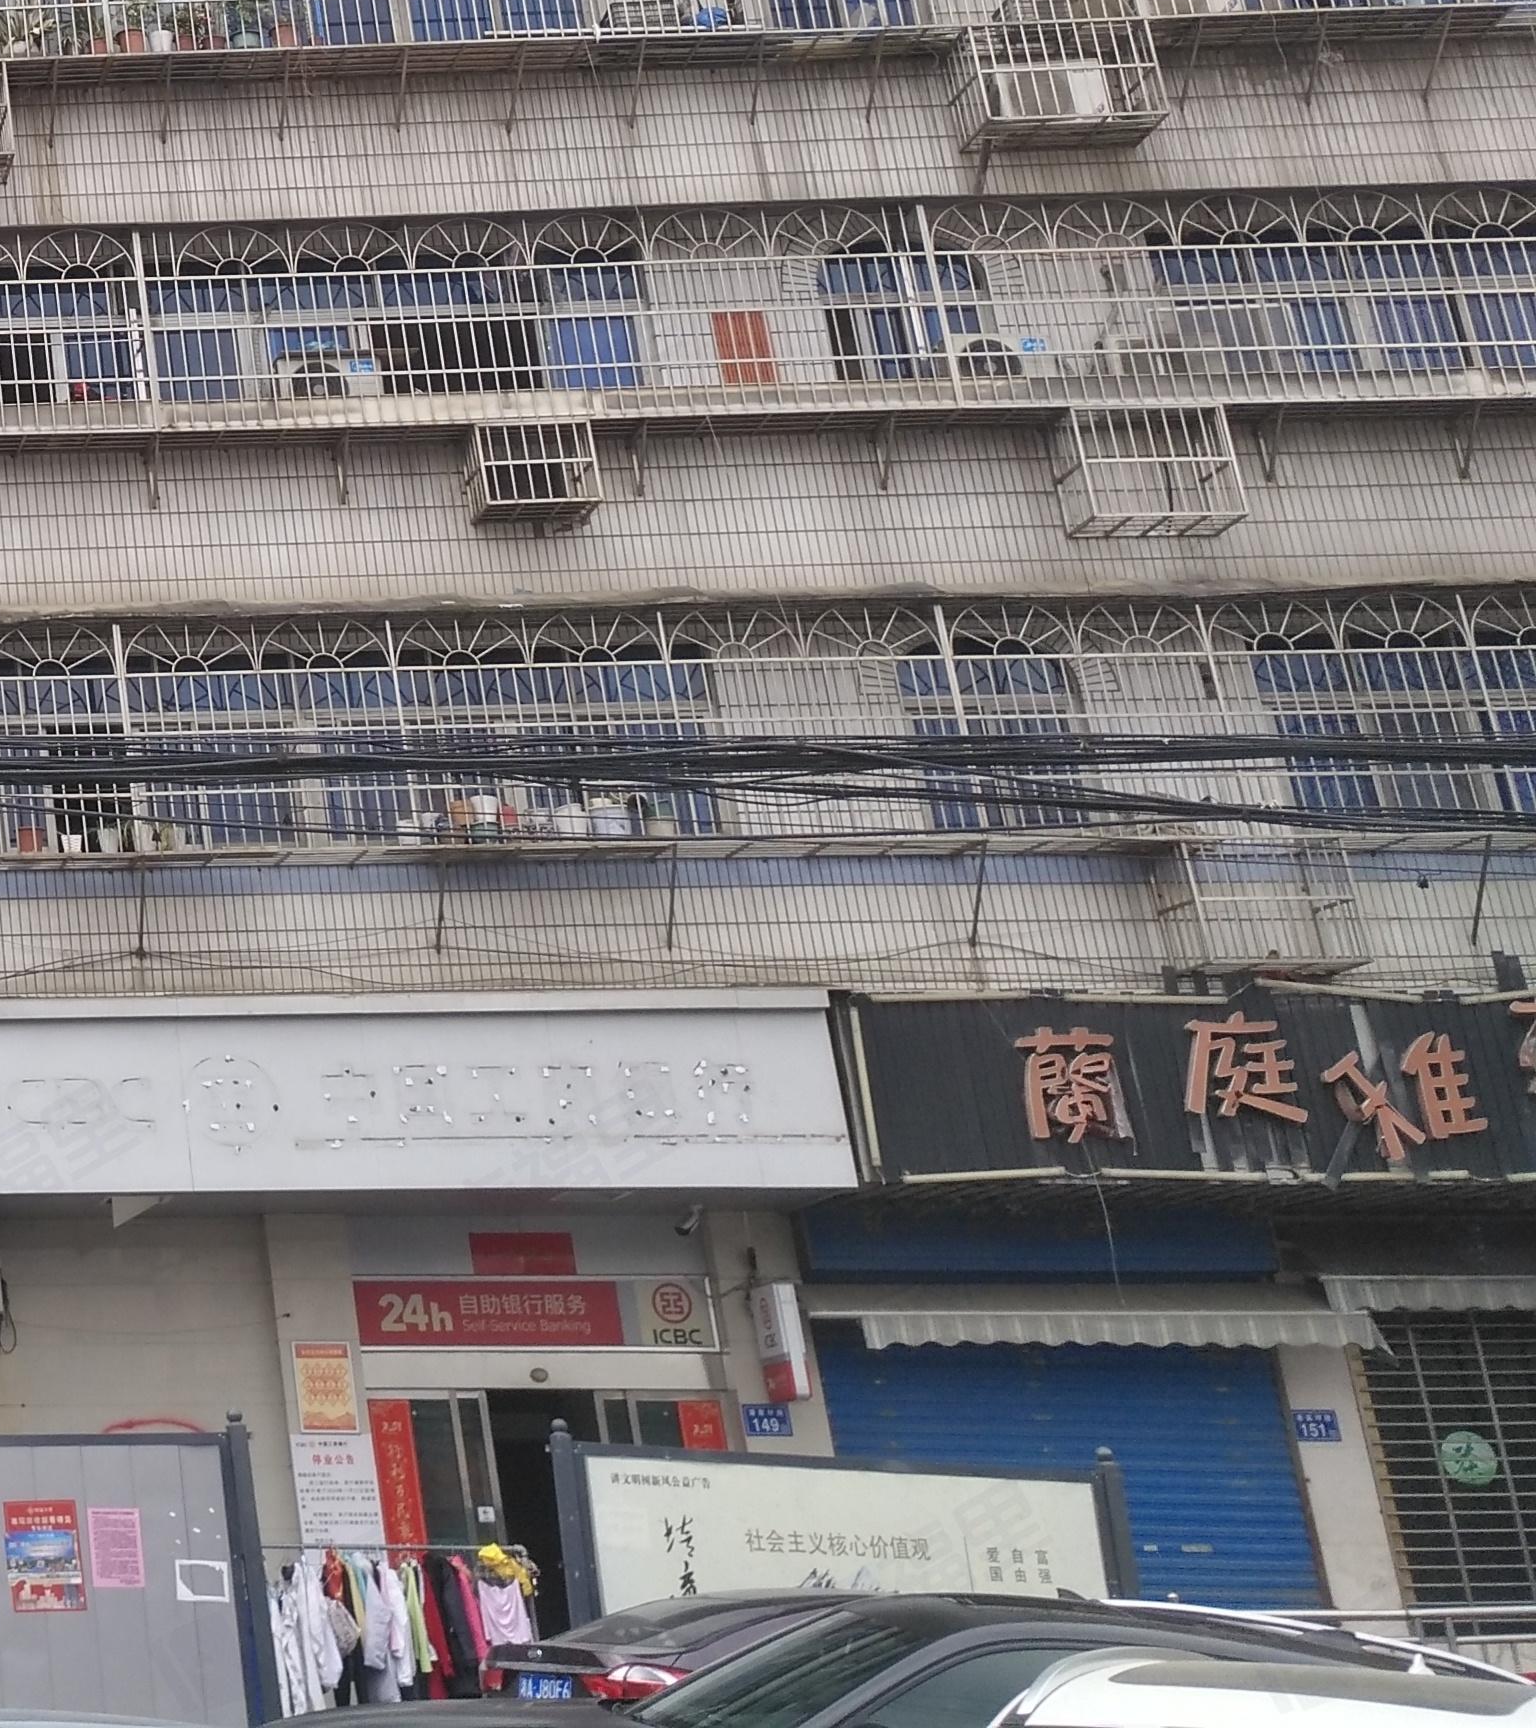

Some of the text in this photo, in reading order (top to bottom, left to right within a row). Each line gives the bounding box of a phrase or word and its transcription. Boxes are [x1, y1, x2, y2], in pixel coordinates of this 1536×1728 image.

[378, 1293, 454, 1333] 24h
[459, 1294, 587, 1316] 自助银行服务
[540, 1318, 592, 1336] Banking
[653, 1328, 704, 1346] ICBC
[744, 1528, 932, 1562] 社会主义核心价值观
